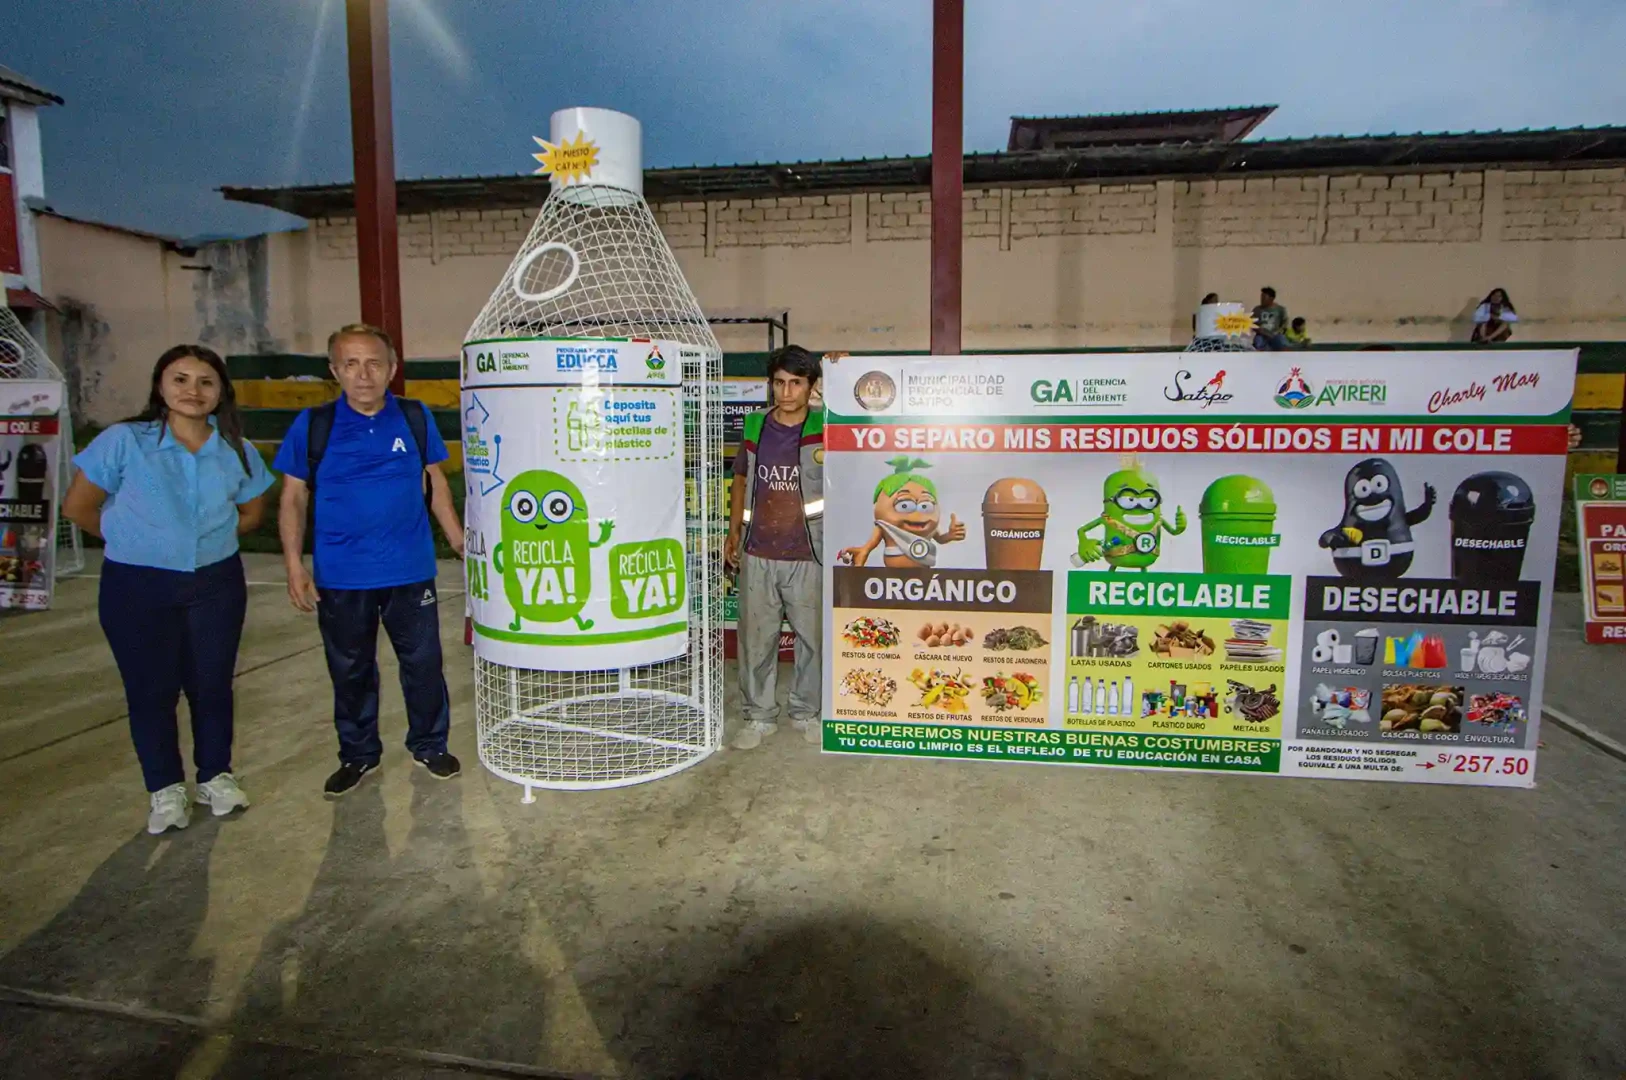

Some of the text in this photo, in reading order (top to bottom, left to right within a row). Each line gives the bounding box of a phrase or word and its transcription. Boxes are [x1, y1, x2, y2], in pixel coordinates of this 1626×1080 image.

[476, 352, 497, 373] GA
[908, 375, 1005, 385] MUNICIPALIDAD
[1082, 378, 1127, 386] GERENCIA
[908, 386, 1003, 396] PROVINCIAL DE
[1030, 379, 1073, 403] GA
[1164, 370, 1234, 409] Satipo
[1315, 384, 1387, 406] AVIRERI
[1427, 371, 1540, 414] Charly May
[908, 397, 952, 407] SATIPO
[1082, 394, 1128, 402] AMBIENTE
[604, 400, 656, 411] Deposita
[605, 414, 652, 425] aquí tus
[10, 421, 40, 434] COLE
[654, 426, 667, 435] de
[851, 422, 1513, 451] YO SEPARO MIS RESIDUOS SÓLIDOS EN MI COLE
[605, 439, 652, 449] plástico
[757, 465, 800, 483] QATA
[990, 529, 1041, 540] ORGÁNICOS
[1215, 534, 1277, 546] RECICLABLE
[1140, 537, 1150, 549] R
[1454, 537, 1525, 550] DESECHABLE
[513, 540, 575, 566] RECICLA
[1370, 547, 1381, 559] D
[619, 548, 677, 577] RECICLA
[515, 566, 577, 606] YA!
[864, 573, 1017, 604] ORGÁNICO
[620, 571, 678, 614] YA!
[1089, 581, 1271, 609] RECICLABLE
[1322, 586, 1518, 616] DESECHABLE
[876, 652, 901, 660] COMIDA
[952, 654, 973, 662] HUEVO
[983, 656, 1003, 664] RESTOS
[1071, 659, 1096, 667] LATAS
[1148, 662, 1183, 670] CARTONES
[1220, 664, 1285, 673] PAPELES USADOS
[1382, 670, 1407, 678] BOLSAS
[866, 710, 898, 718] PANADERIA
[1013, 716, 1045, 724] VERDURAS
[1067, 718, 1097, 726] BOTELLAS
[1152, 721, 1206, 730] PLASTICO DURO
[1302, 728, 1369, 737] PAÑALES USADOS
[1435, 733, 1459, 741] COCO
[967, 729, 1060, 745] NUESTRAS
[1066, 734, 1139, 748] BUENAS
[1464, 735, 1516, 744] ENVOLTURA
[838, 737, 1262, 765] TU COLEGIO LIMPIO ES EL REFLEJO DE TU EDUCACIÓN EN CASA
[1453, 754, 1529, 775] 257.50
